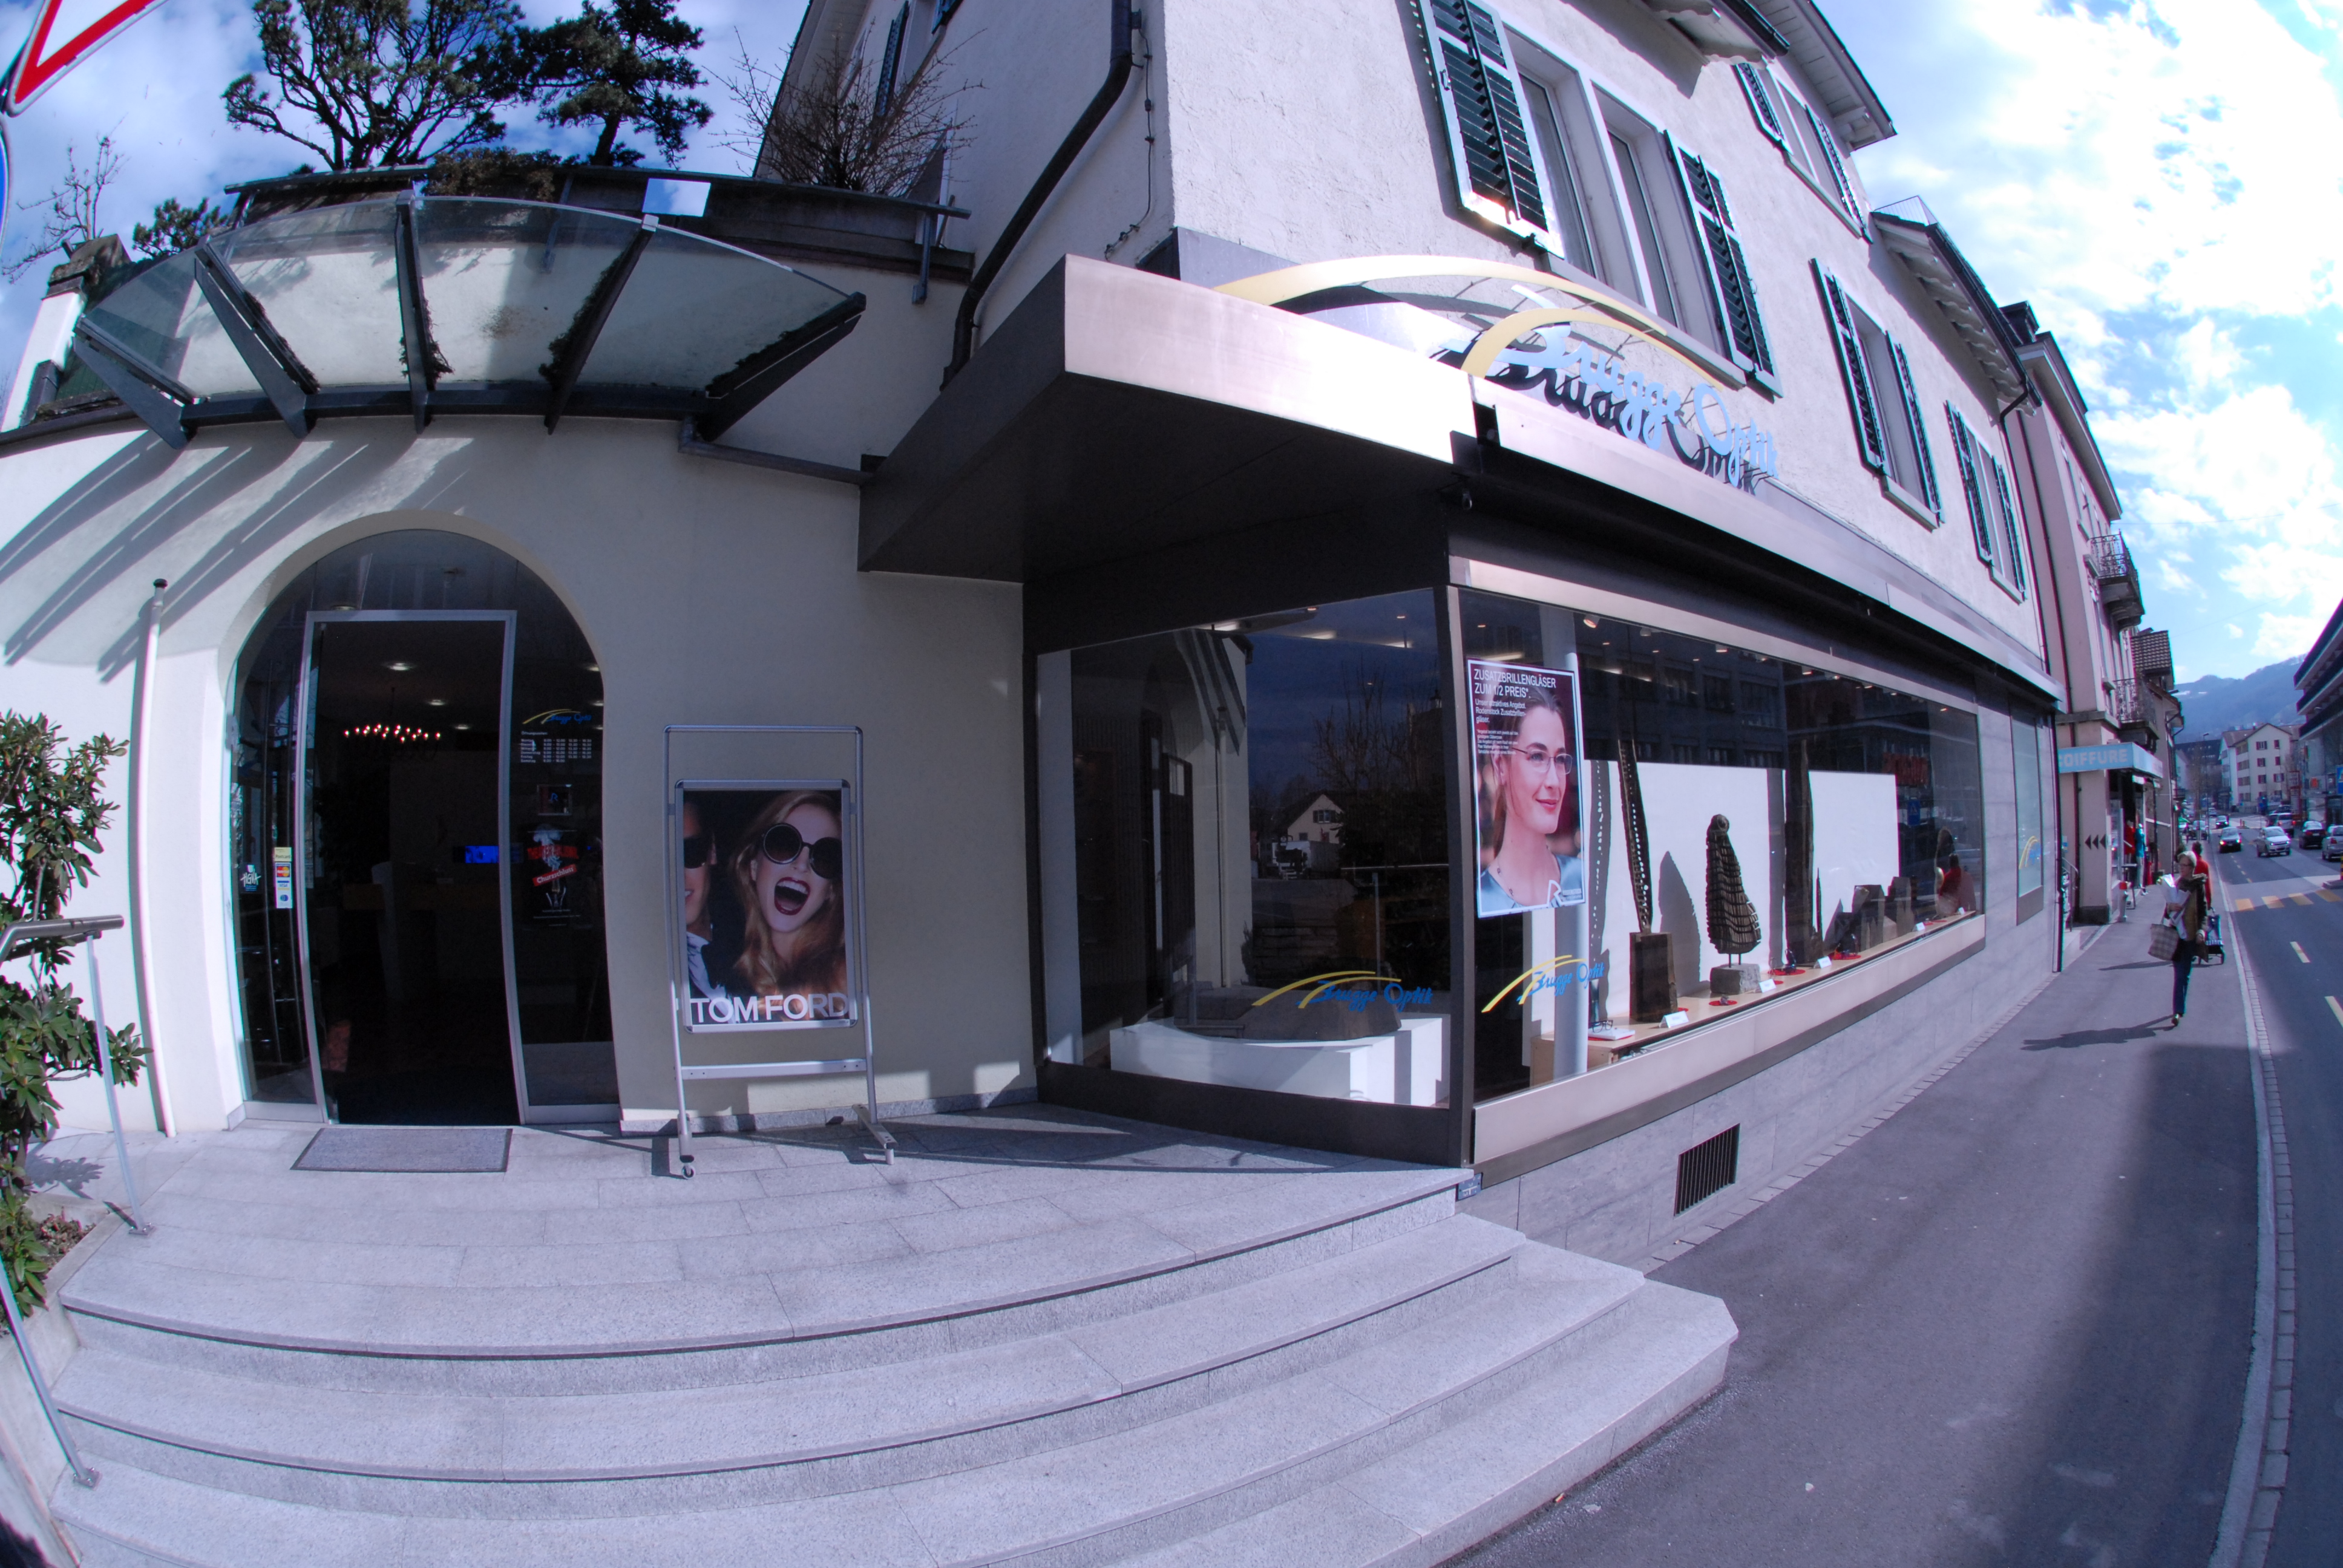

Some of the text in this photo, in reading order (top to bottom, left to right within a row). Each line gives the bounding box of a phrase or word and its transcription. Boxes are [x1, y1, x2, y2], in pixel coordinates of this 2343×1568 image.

[1439, 284, 1778, 487] Brugge Optik
[1474, 668, 1556, 688] ZUSATZBRILLENGLÄSER
[1475, 682, 1492, 695] ZUM
[1494, 685, 1503, 696] 1/2
[1475, 707, 1499, 715] Rodenstock
[1296, 980, 1434, 1013] Brugge Optik
[1516, 962, 1605, 1002] Brugge Optik
[690, 992, 848, 1023] TOM FORD
